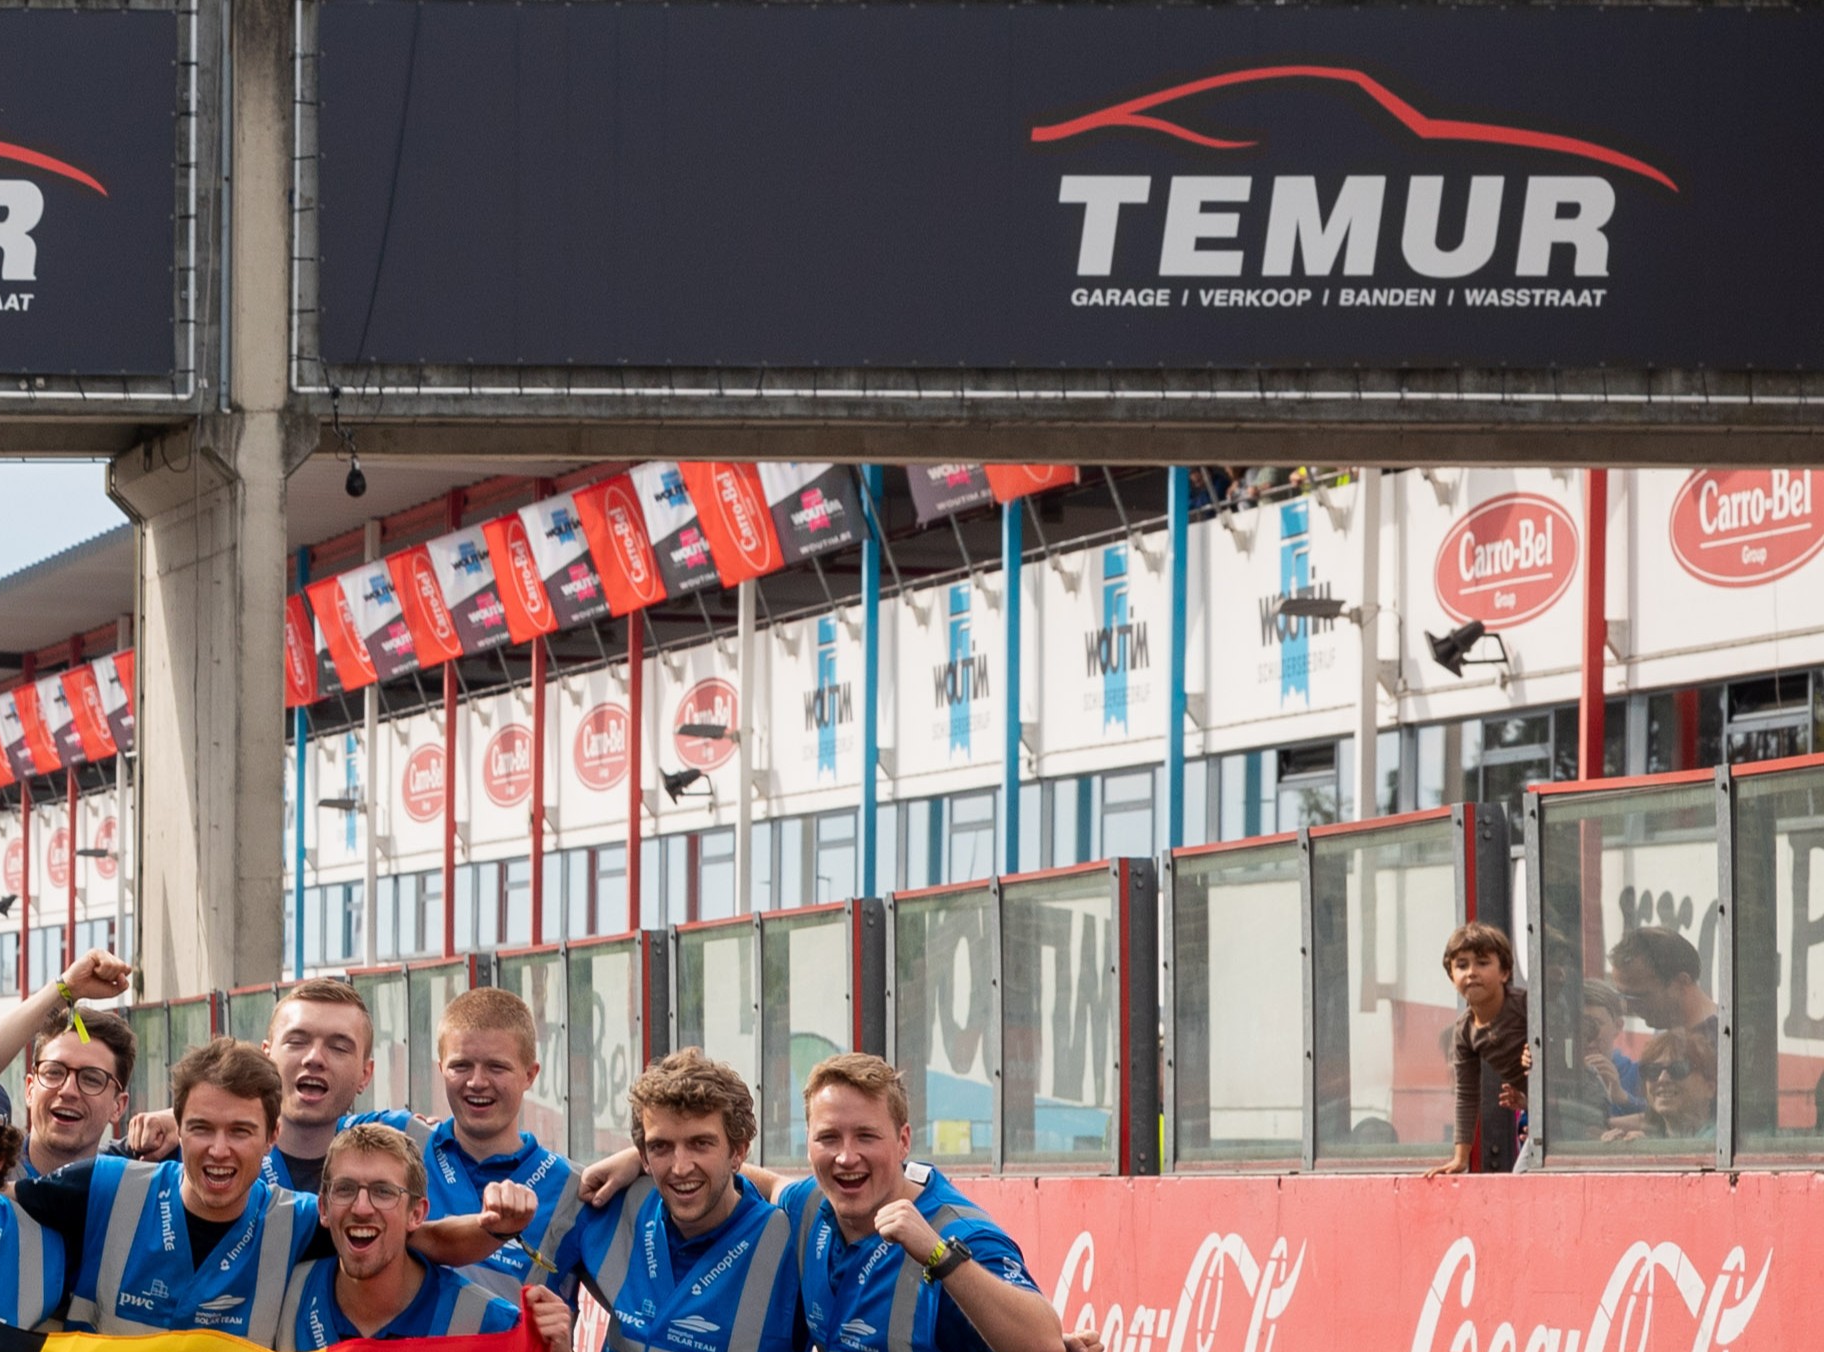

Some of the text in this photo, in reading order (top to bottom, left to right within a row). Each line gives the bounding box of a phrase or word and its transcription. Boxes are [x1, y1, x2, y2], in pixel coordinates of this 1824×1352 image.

[1058, 175, 1616, 279] TEMUR
[1070, 288, 1607, 308] GARAGE VERKOOP BANDEN WASSTRAAT
[716, 472, 758, 553] Carro-Bel
[1700, 469, 1812, 535] Carro-Bel
[608, 507, 645, 584] Carro-Bel
[1459, 515, 1553, 582] Carro-Bel
[1742, 545, 1767, 566] Group
[1494, 591, 1516, 609] Group
[582, 718, 626, 758] Carro-Bel
[702, 1239, 750, 1288] innoptus
